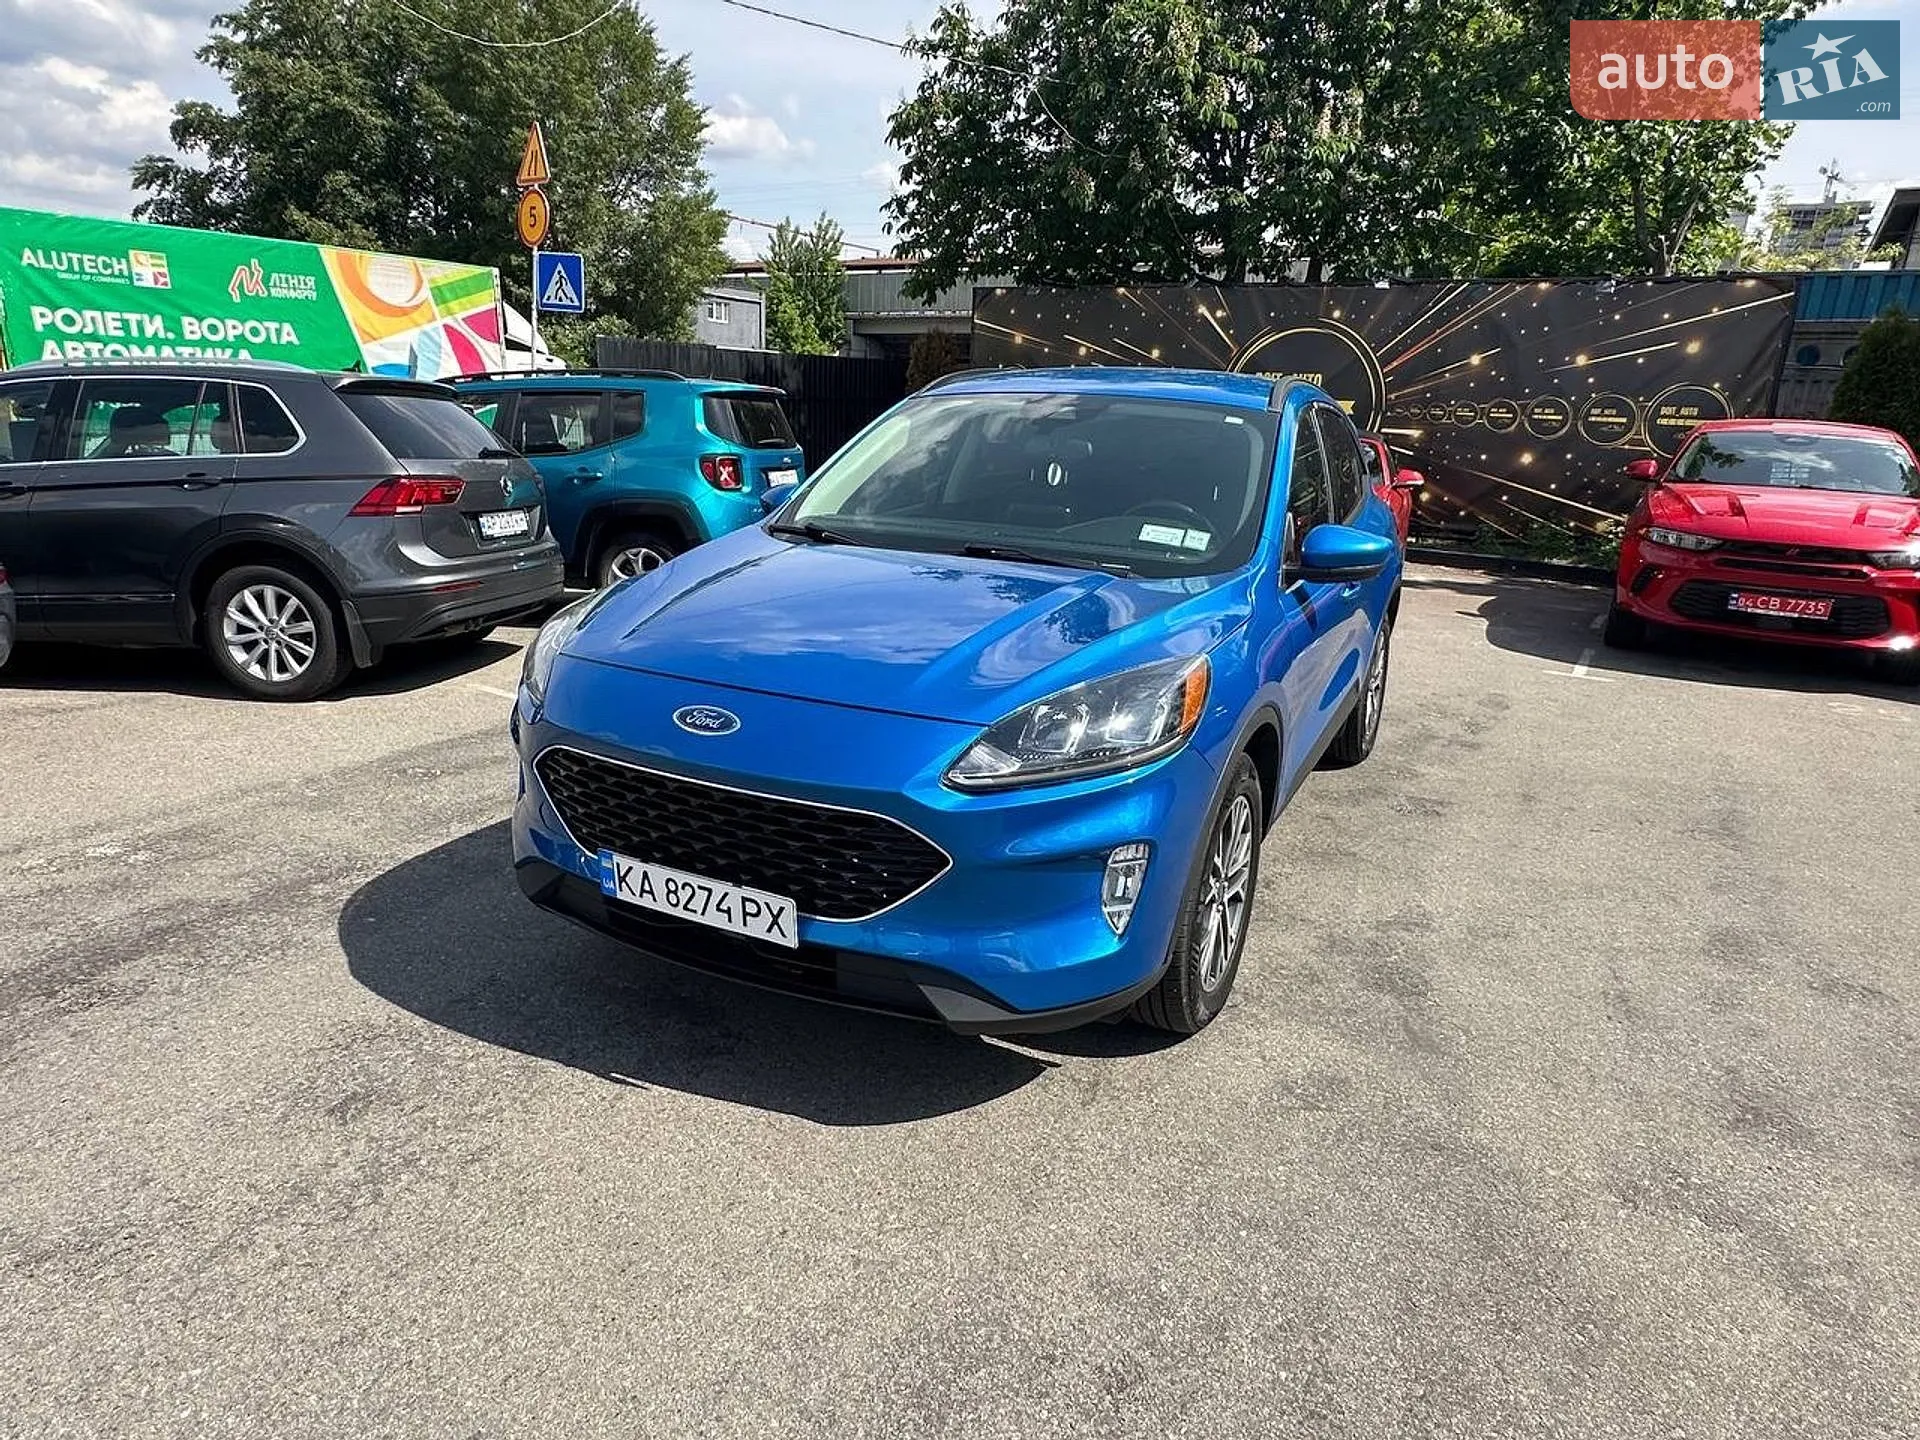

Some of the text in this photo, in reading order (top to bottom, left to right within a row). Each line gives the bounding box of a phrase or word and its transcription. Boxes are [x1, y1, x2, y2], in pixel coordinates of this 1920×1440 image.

[529, 205, 537, 228] 5
[21, 247, 129, 276] ALUTECH
[269, 272, 316, 289] ЛІНІЯ
[30, 305, 300, 345] РОЛЕТИ. ВОРОТА
[1786, 600, 1826, 615] 7735
[686, 709, 725, 728] Ford
[616, 862, 788, 938] KA 8274 PX
